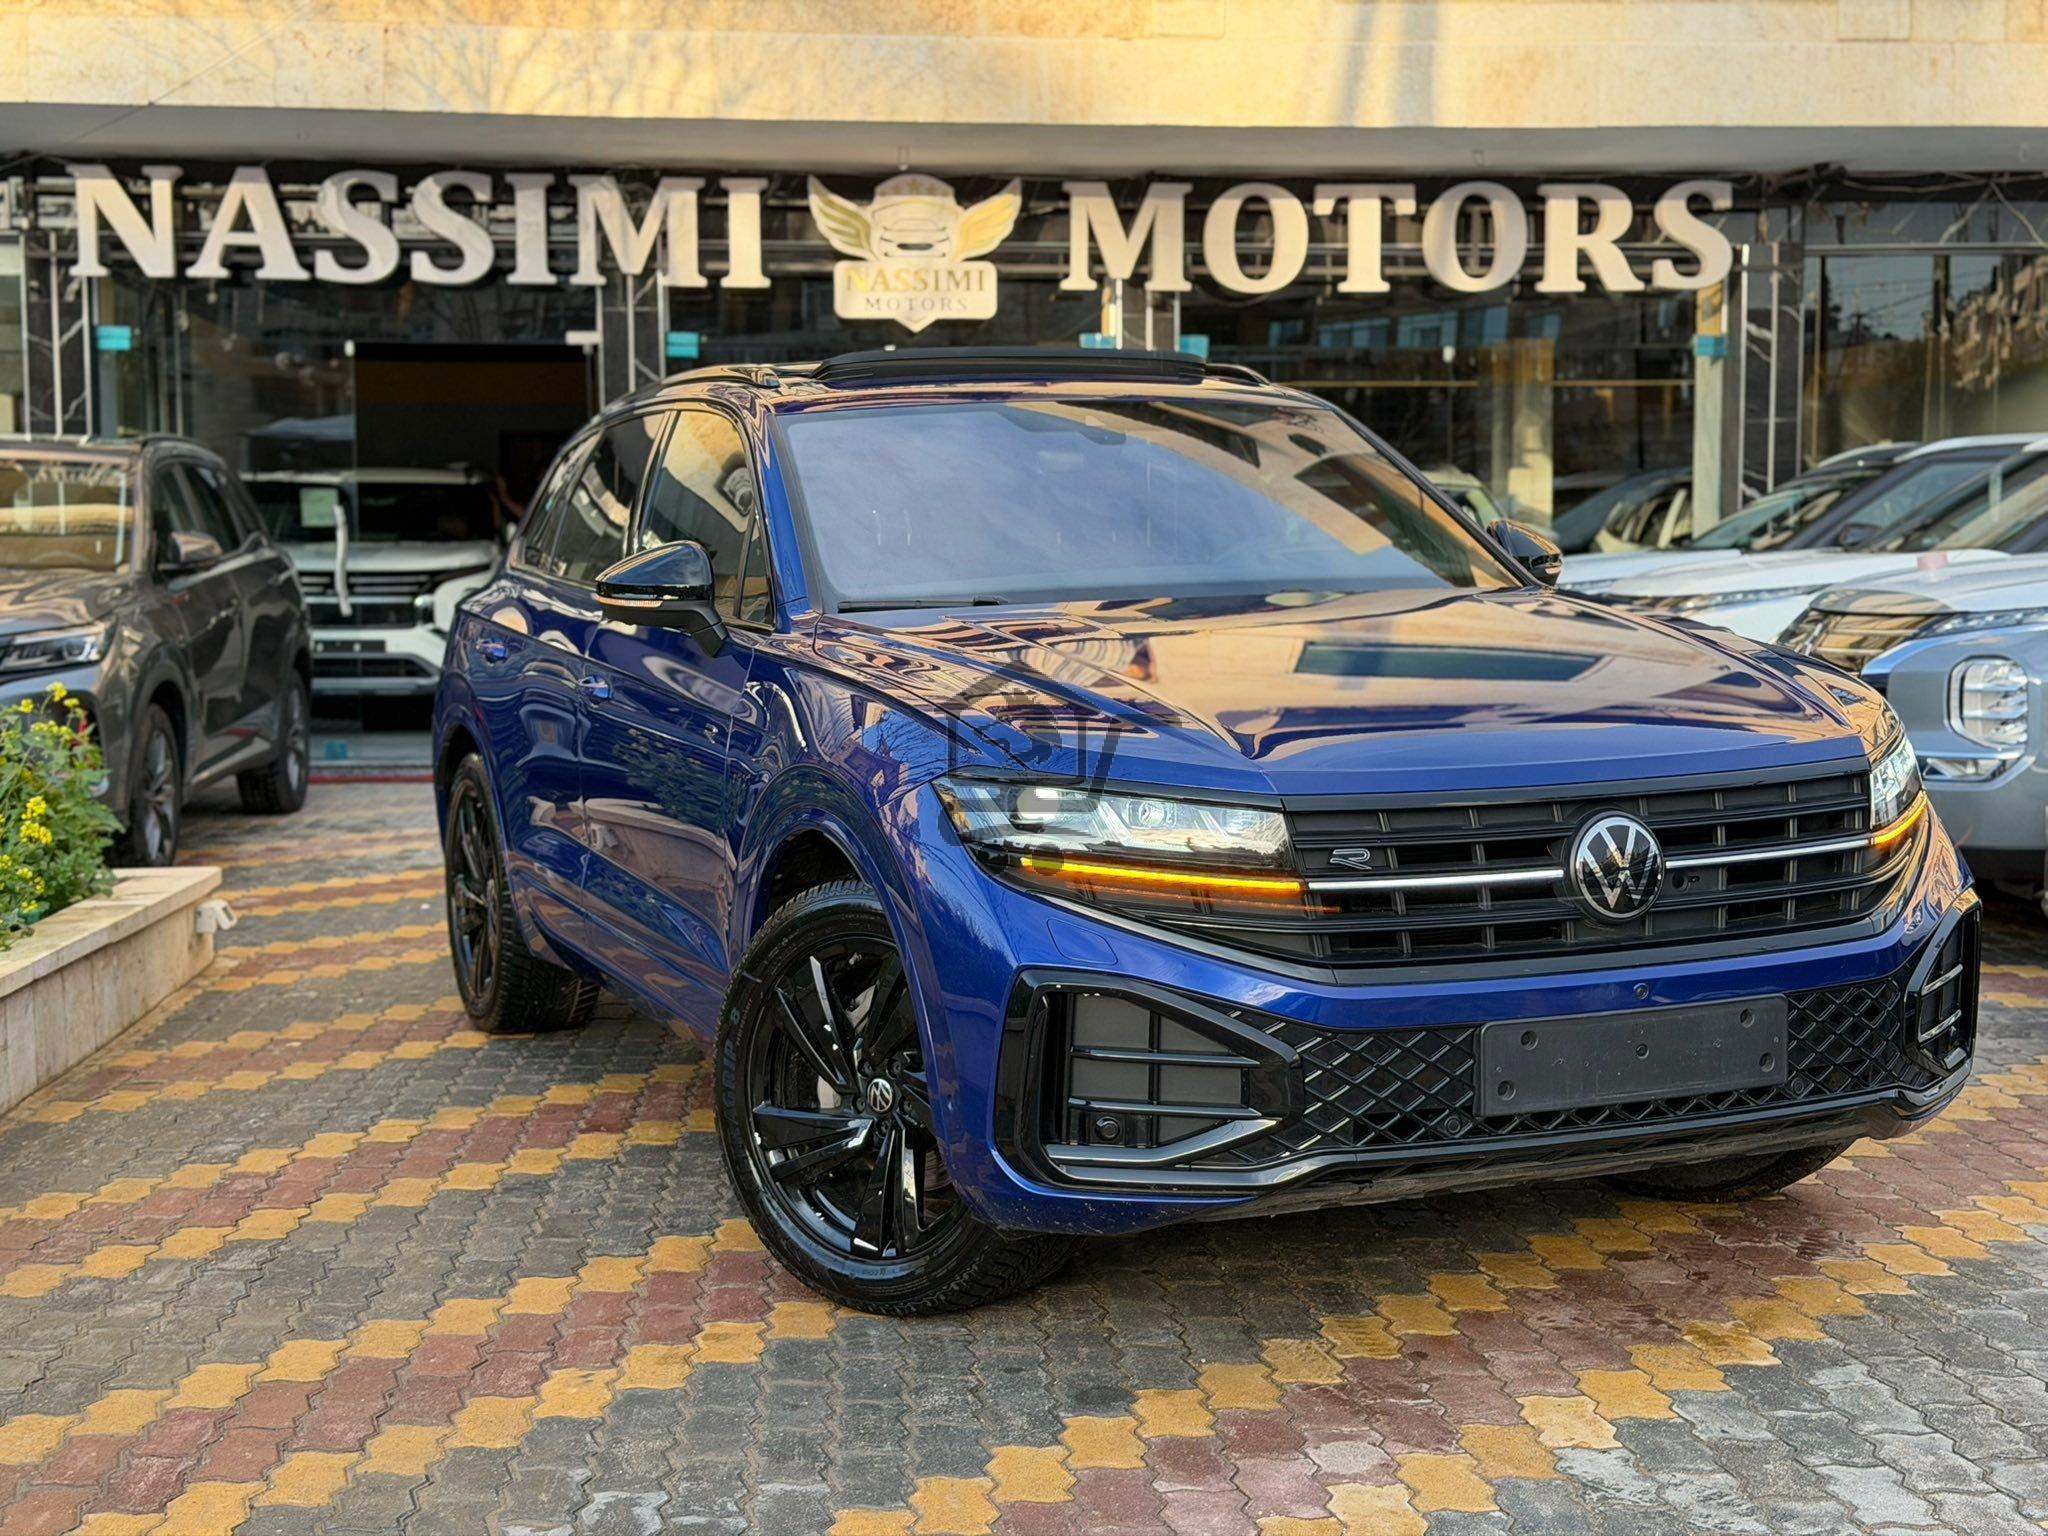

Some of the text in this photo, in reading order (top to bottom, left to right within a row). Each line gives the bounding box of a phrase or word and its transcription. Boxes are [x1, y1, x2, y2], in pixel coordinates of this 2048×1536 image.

[66, 164, 1733, 294] NASSIMI MOTORS
[846, 266, 985, 293] NASSIMI
[865, 296, 968, 312] MOTORS
